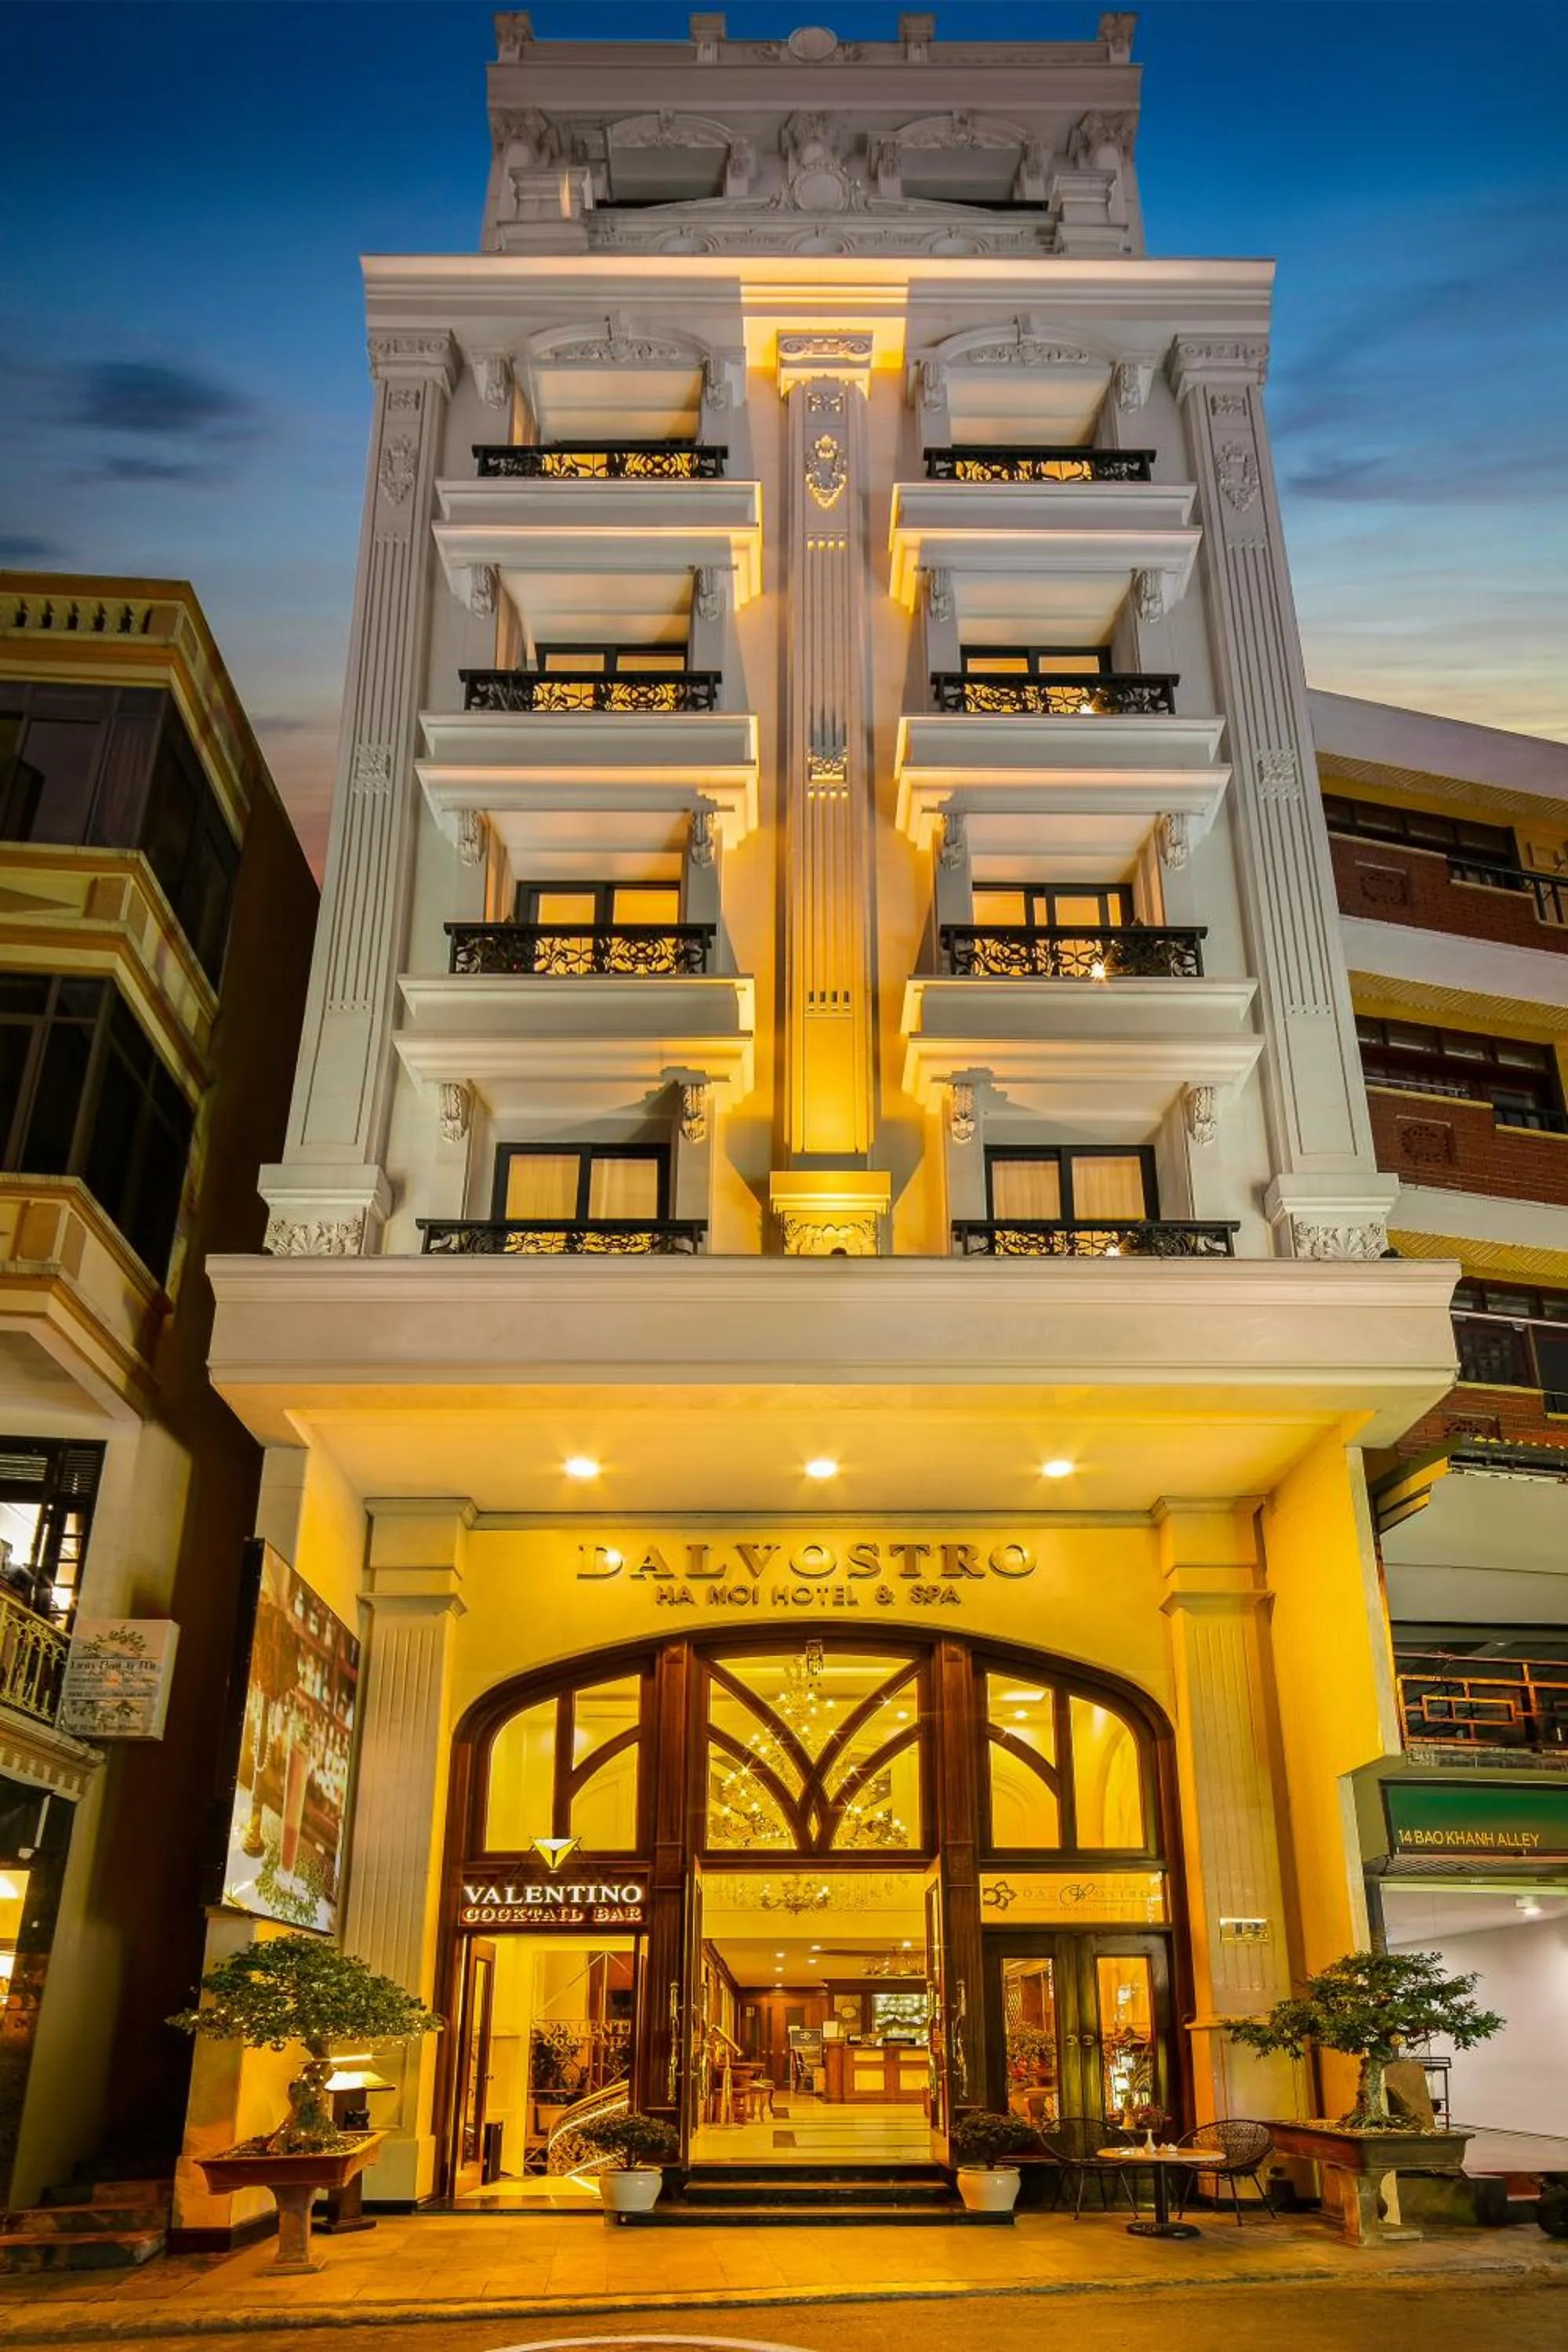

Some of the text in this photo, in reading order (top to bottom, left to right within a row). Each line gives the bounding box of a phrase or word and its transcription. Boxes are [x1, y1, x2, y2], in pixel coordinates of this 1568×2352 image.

[576, 1544, 1039, 1581] DALVOSTRO
[655, 1584, 962, 1606] HA NOI HOTEL & SPA
[1414, 1830, 1443, 1845] BAO
[1445, 1831, 1494, 1846] KHANH
[1497, 1832, 1540, 1847] ALLEY
[463, 1885, 643, 1904] VALENTINO
[463, 1906, 643, 1922] COCKTAIL BAR
